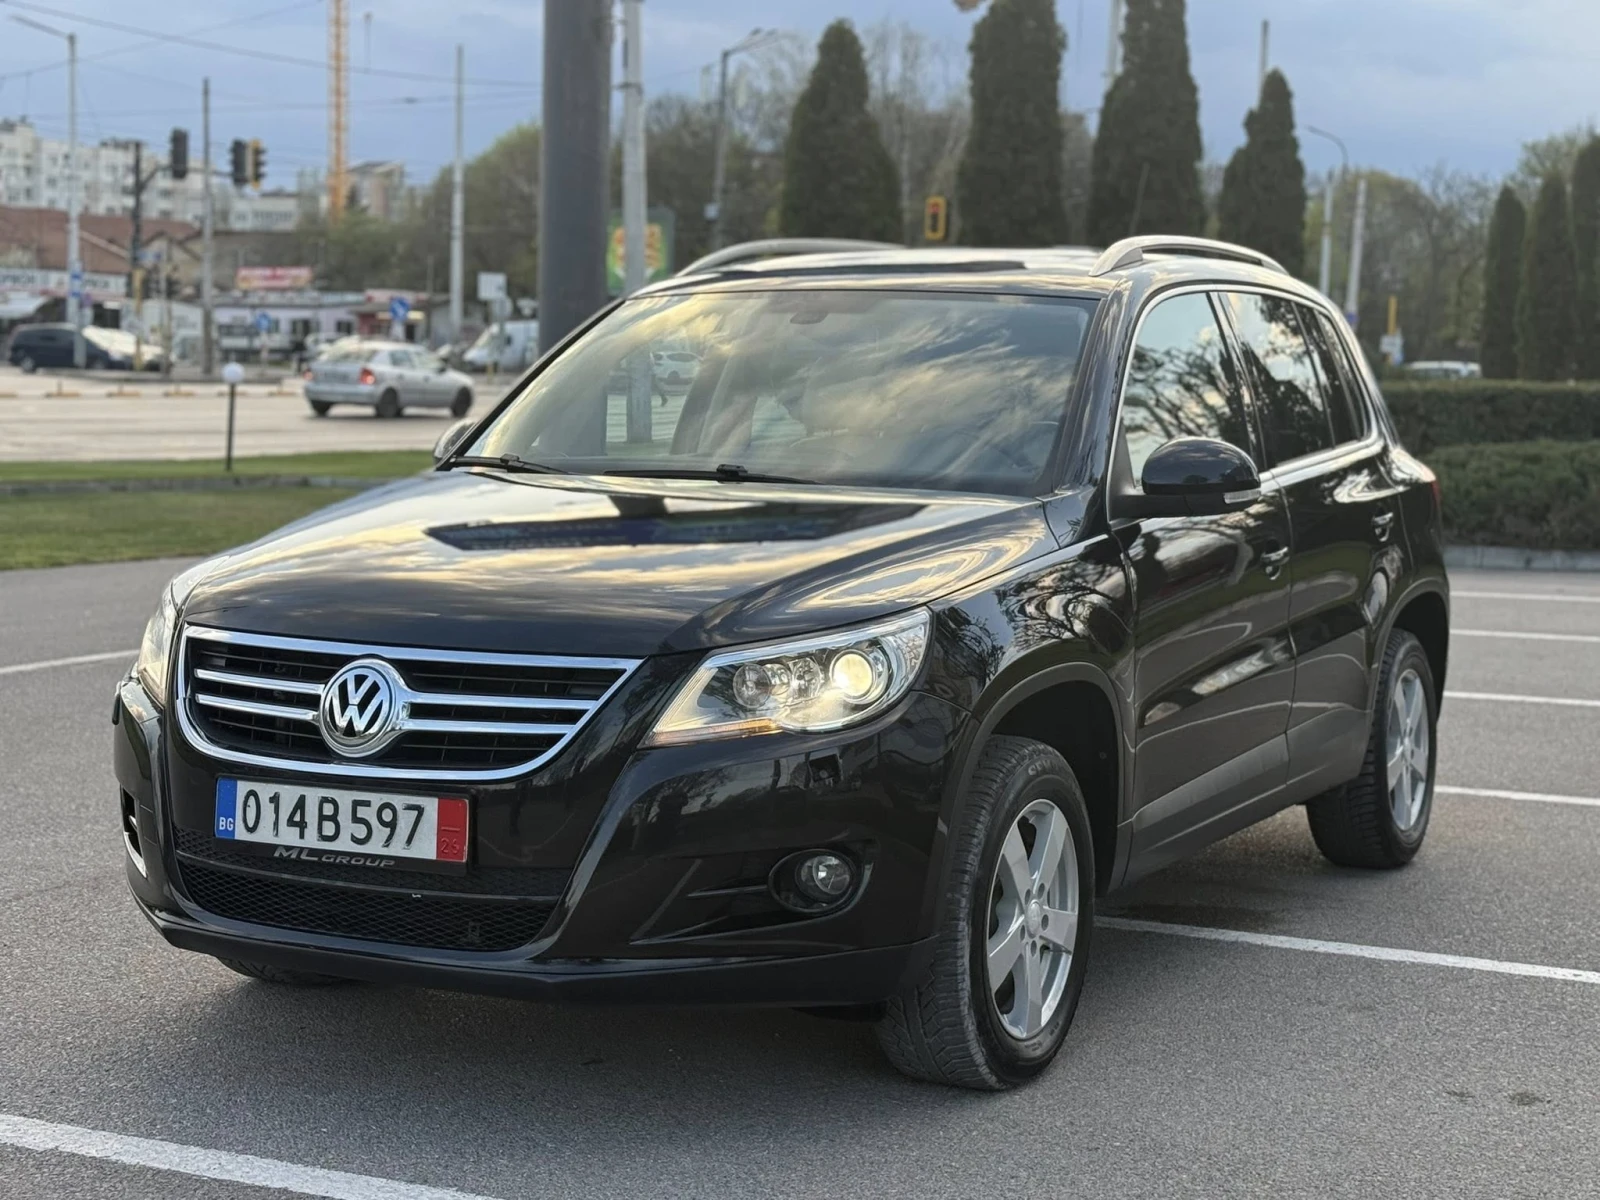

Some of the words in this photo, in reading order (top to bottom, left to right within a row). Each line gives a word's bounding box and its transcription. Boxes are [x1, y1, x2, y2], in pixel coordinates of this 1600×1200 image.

[324, 664, 392, 748] VW
[219, 816, 234, 831] BG
[242, 789, 425, 850] 014B597
[273, 846, 319, 861] ML
[321, 854, 395, 868] GROUP
